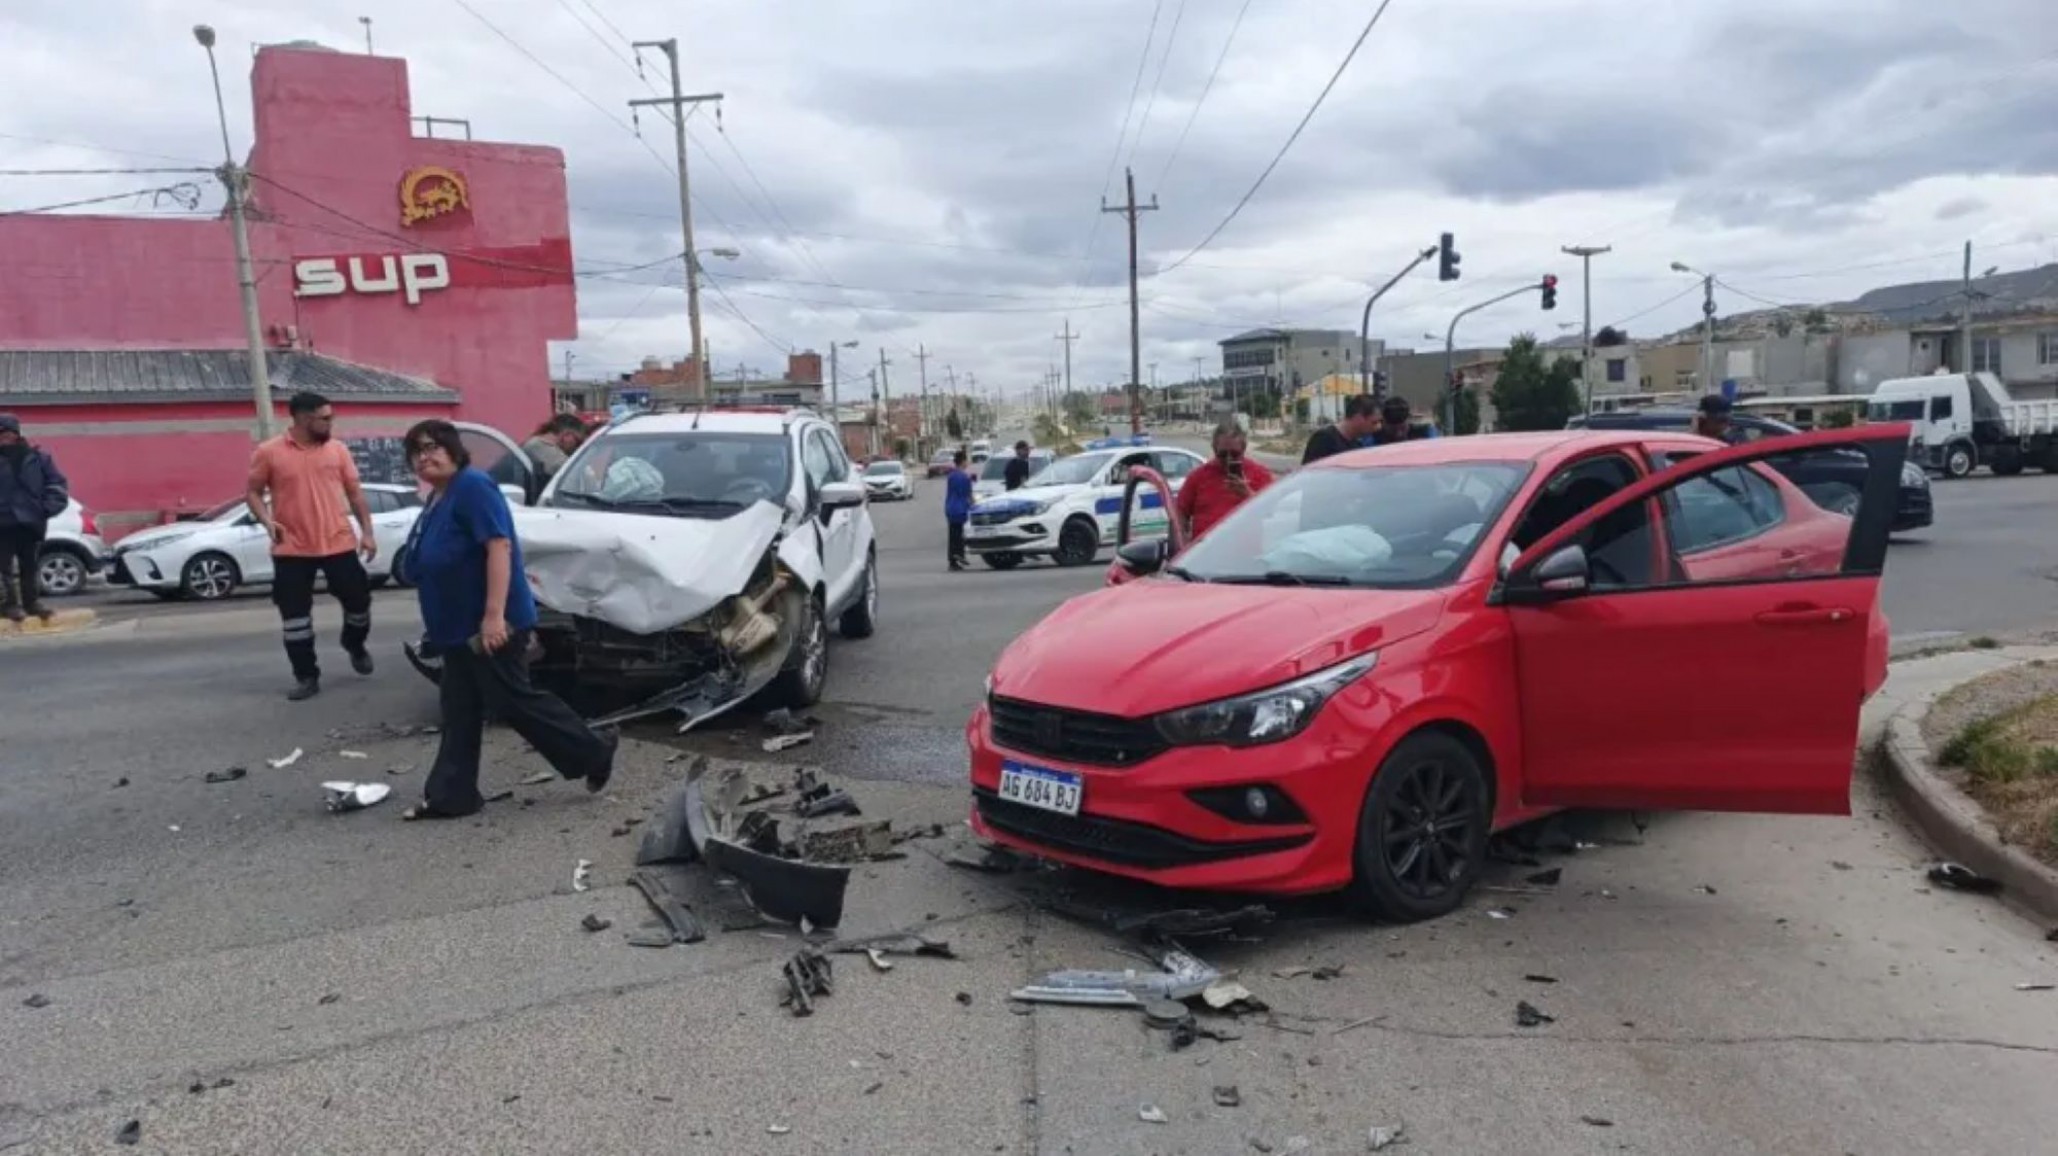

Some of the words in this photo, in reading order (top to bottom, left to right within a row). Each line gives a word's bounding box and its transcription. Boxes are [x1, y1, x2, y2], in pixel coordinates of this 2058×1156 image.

[1002, 774, 1021, 797] AG
[1024, 778, 1051, 803] 684
[1056, 784, 1077, 809] BJ
